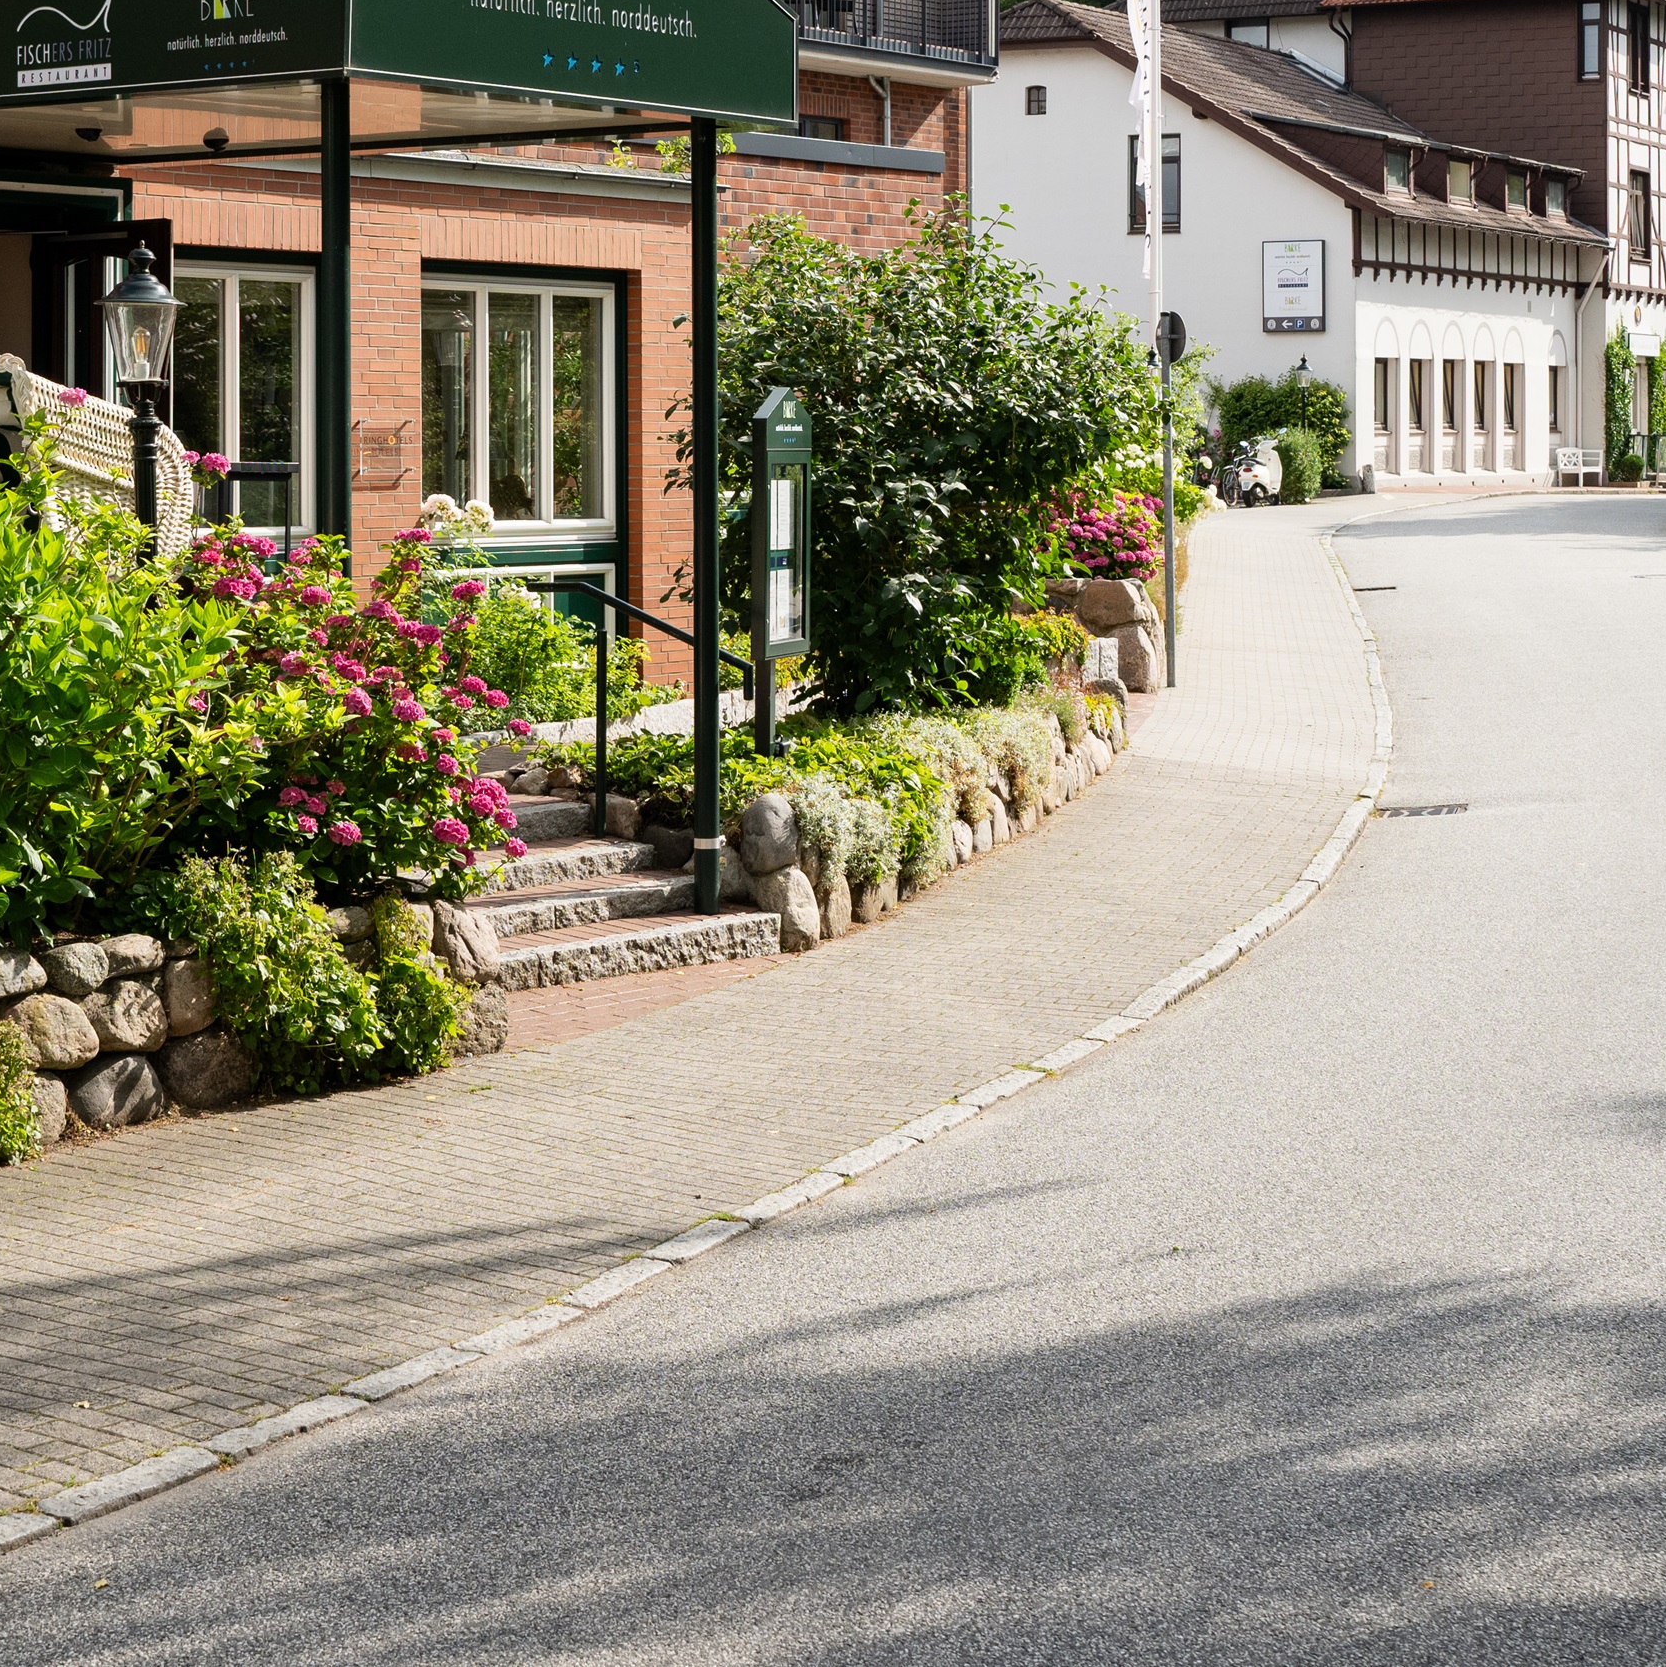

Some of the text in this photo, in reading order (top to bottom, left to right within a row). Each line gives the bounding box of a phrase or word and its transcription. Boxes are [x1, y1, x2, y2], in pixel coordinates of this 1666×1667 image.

[612, 2, 697, 39] norddeutsch.
[167, 26, 289, 51] natürlich. herzlich. norddeutsch.
[16, 37, 112, 66] FISCHERS FRITZ
[21, 66, 108, 84] RESTAURANT
[1296, 320, 1303, 328] P
[363, 435, 413, 445] RINGHOTELS
